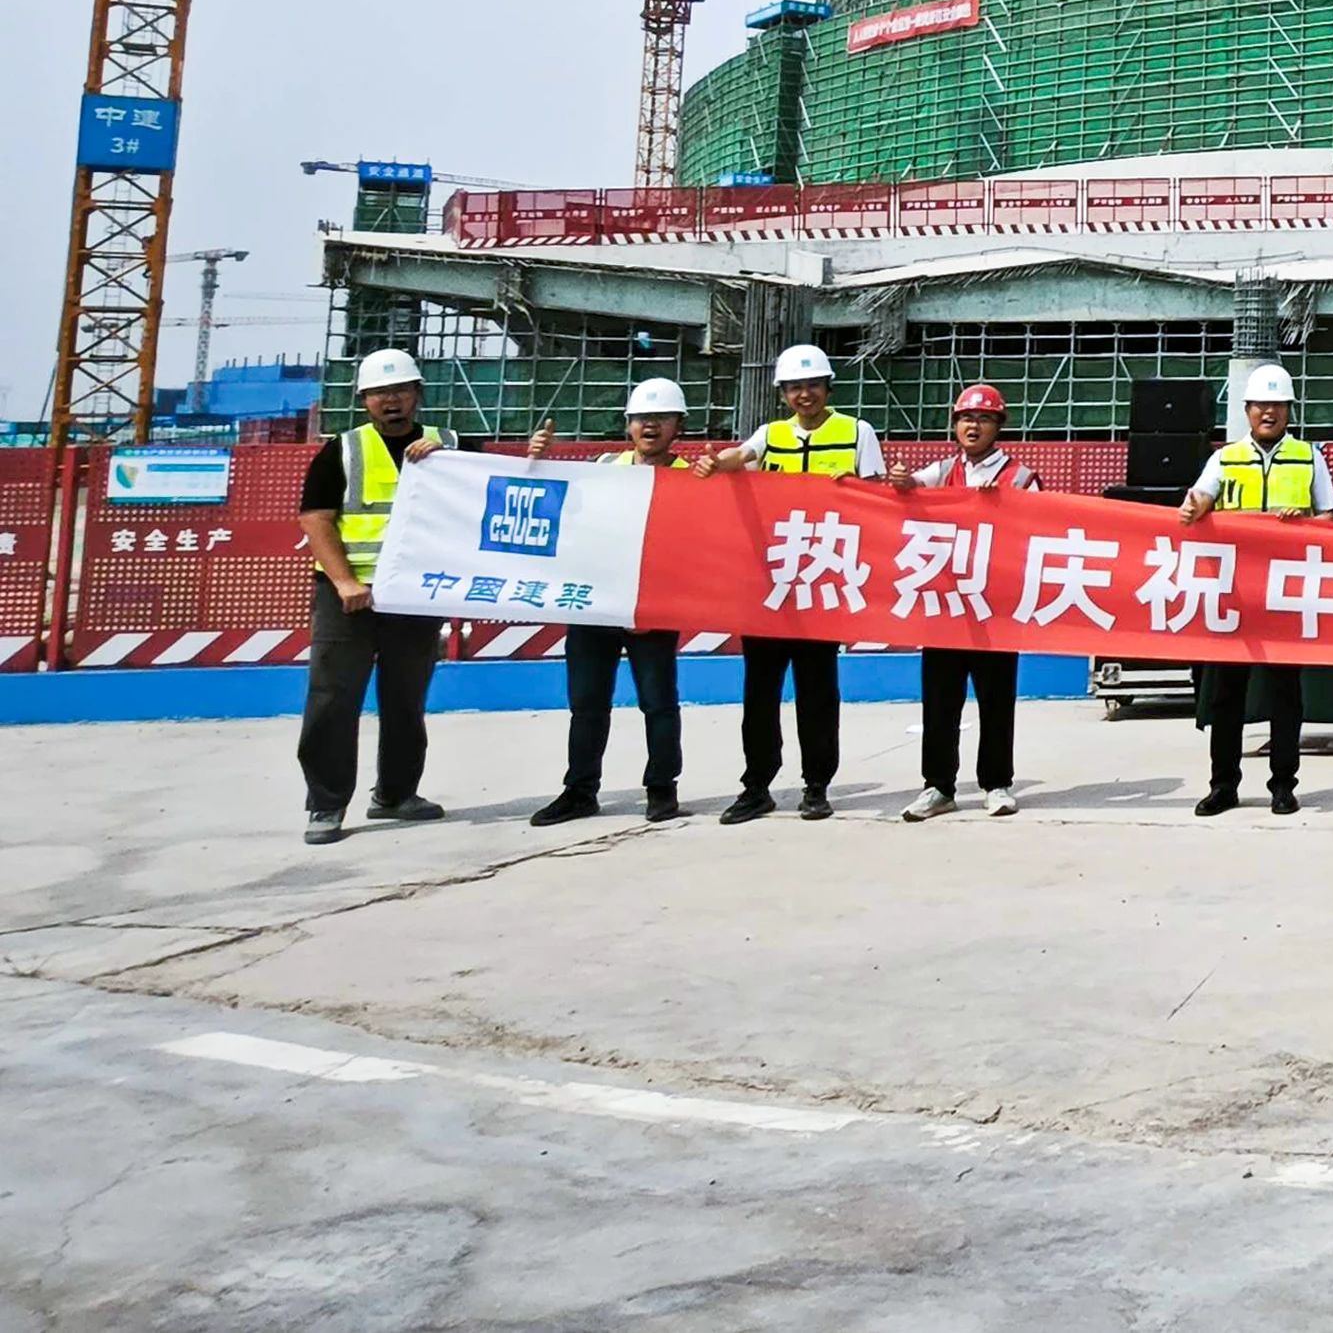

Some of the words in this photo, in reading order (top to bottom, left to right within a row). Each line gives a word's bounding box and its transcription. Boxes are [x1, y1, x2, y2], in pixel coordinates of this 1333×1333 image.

[94, 106, 163, 130] 中建
[110, 137, 140, 154] 3#
[110, 528, 233, 552] 安全生产
